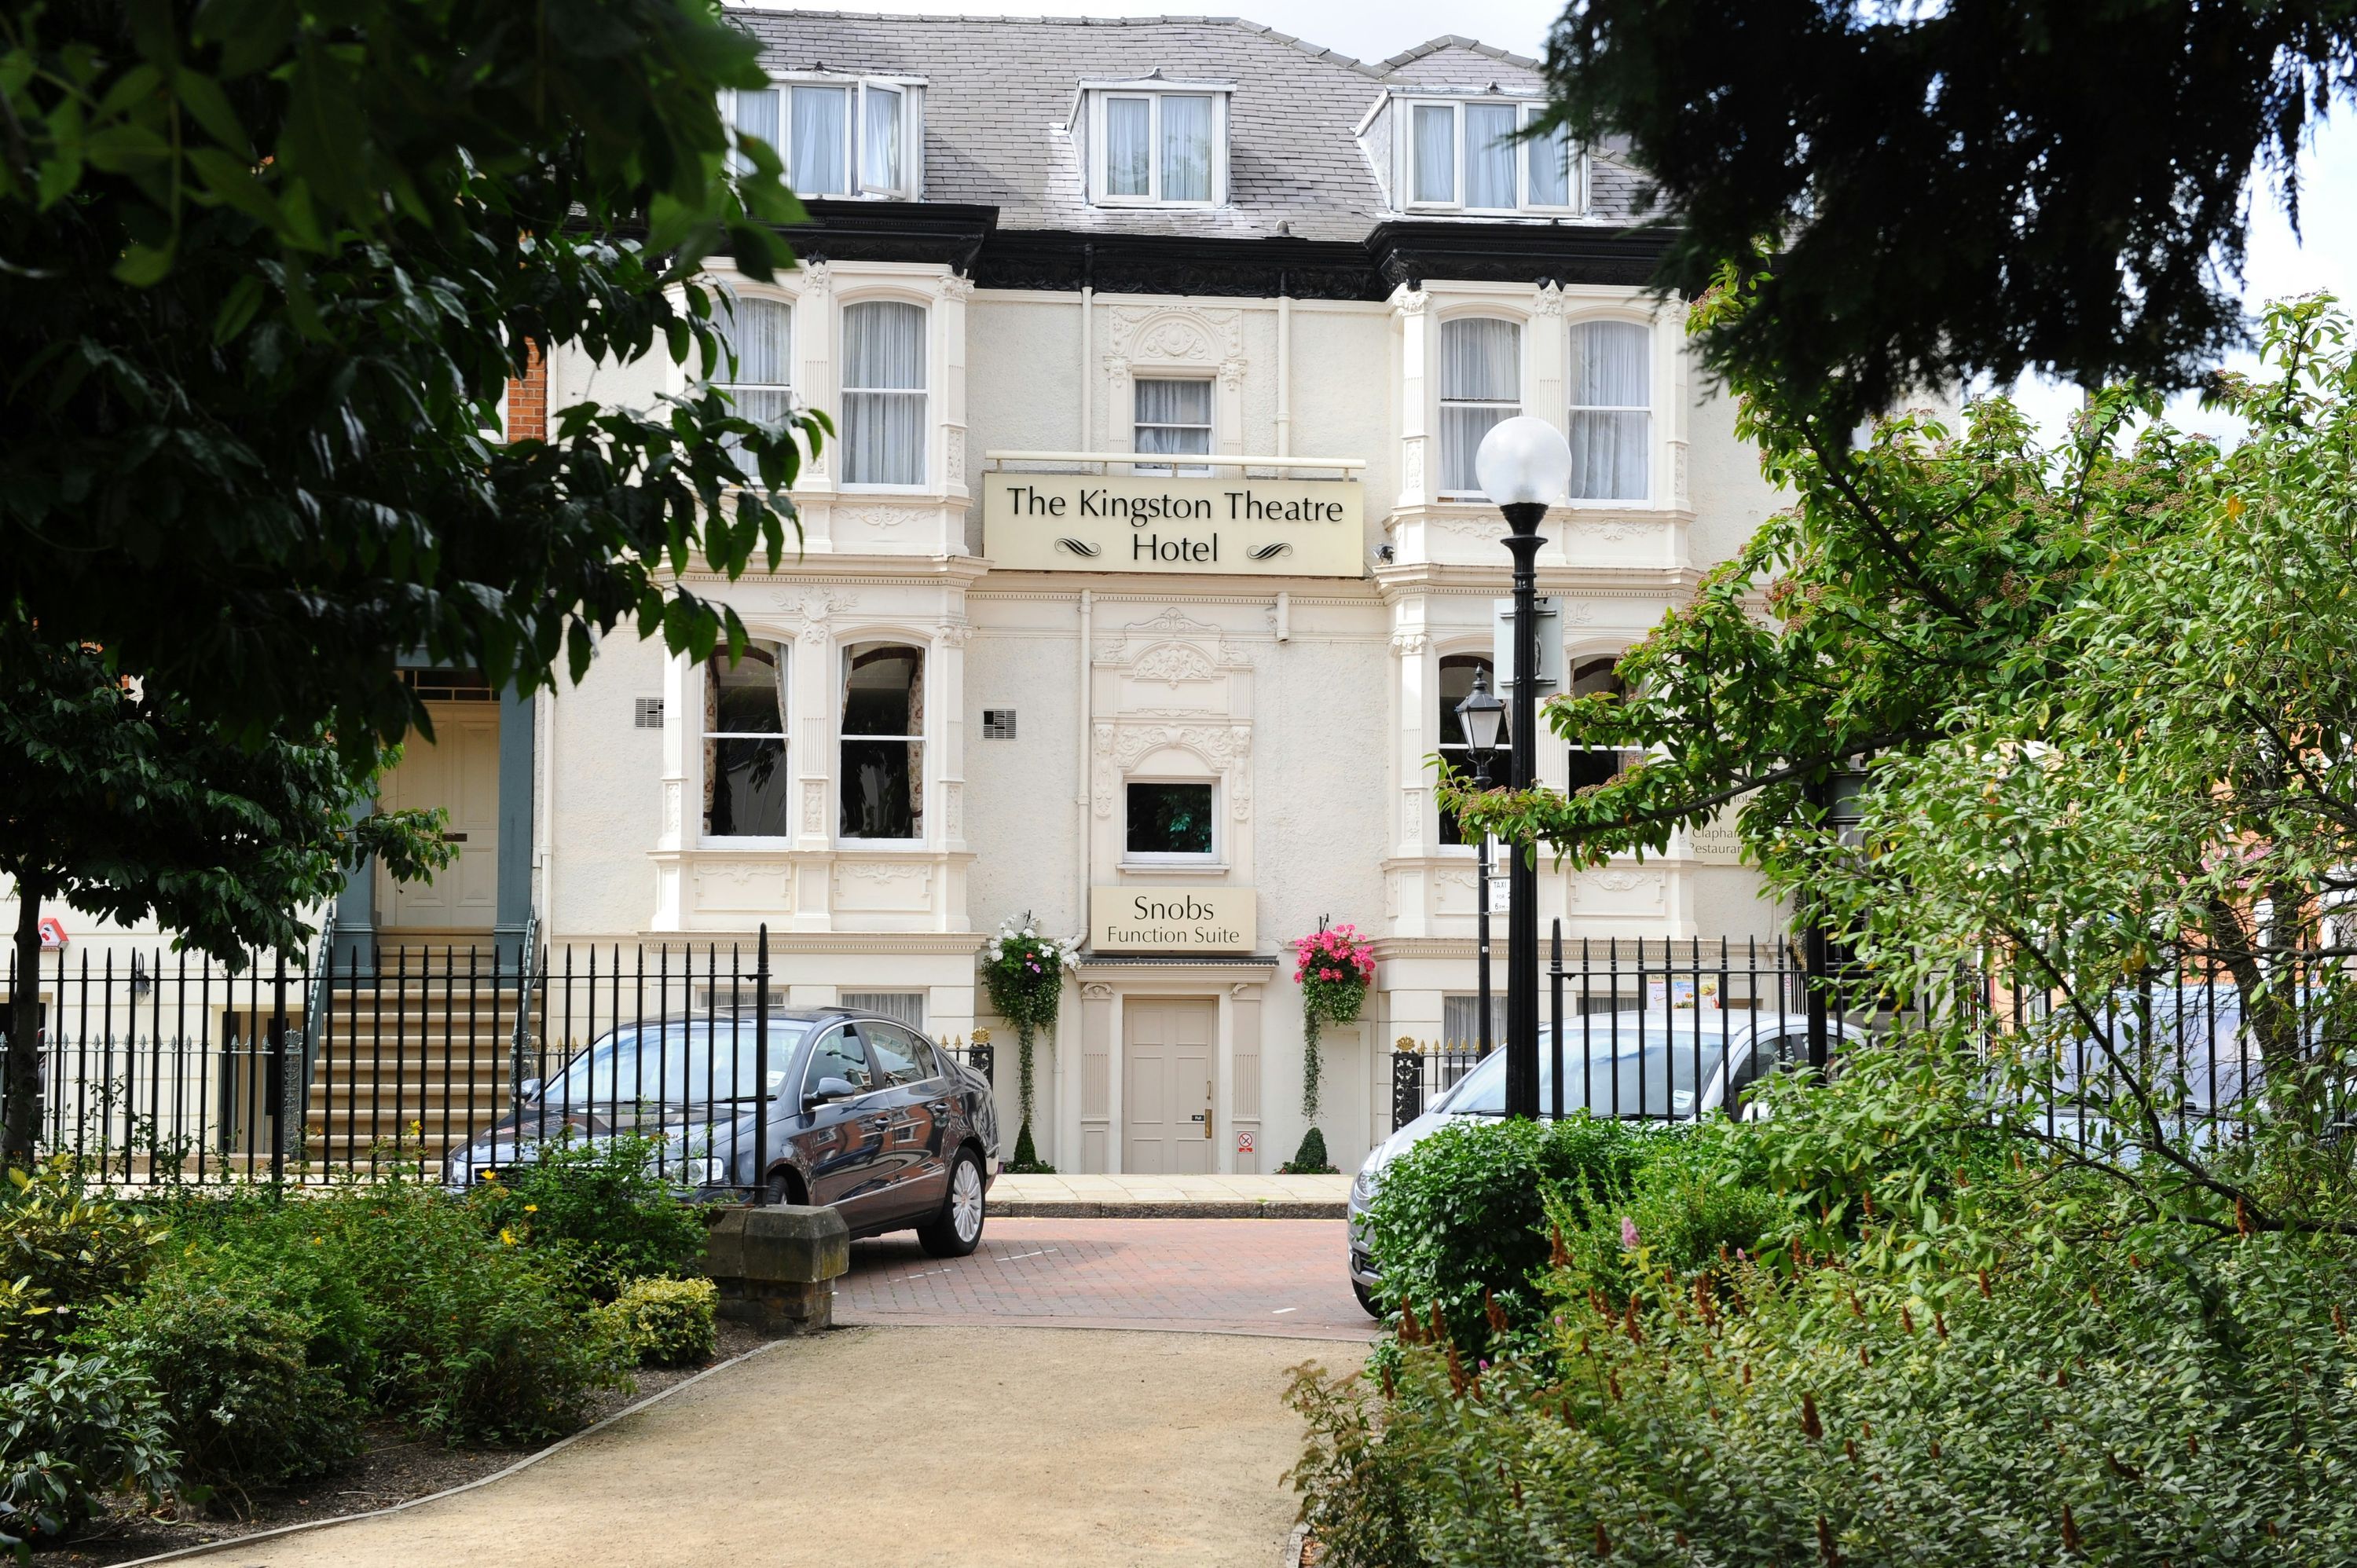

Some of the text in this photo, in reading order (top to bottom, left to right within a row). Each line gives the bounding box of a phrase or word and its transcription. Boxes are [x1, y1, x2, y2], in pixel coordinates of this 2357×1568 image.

[1006, 486, 1343, 526] The Kingston Theatre
[1133, 533, 1218, 562] Hotel
[1134, 895, 1214, 920] Snobs
[1108, 925, 1240, 943] Function Suite
